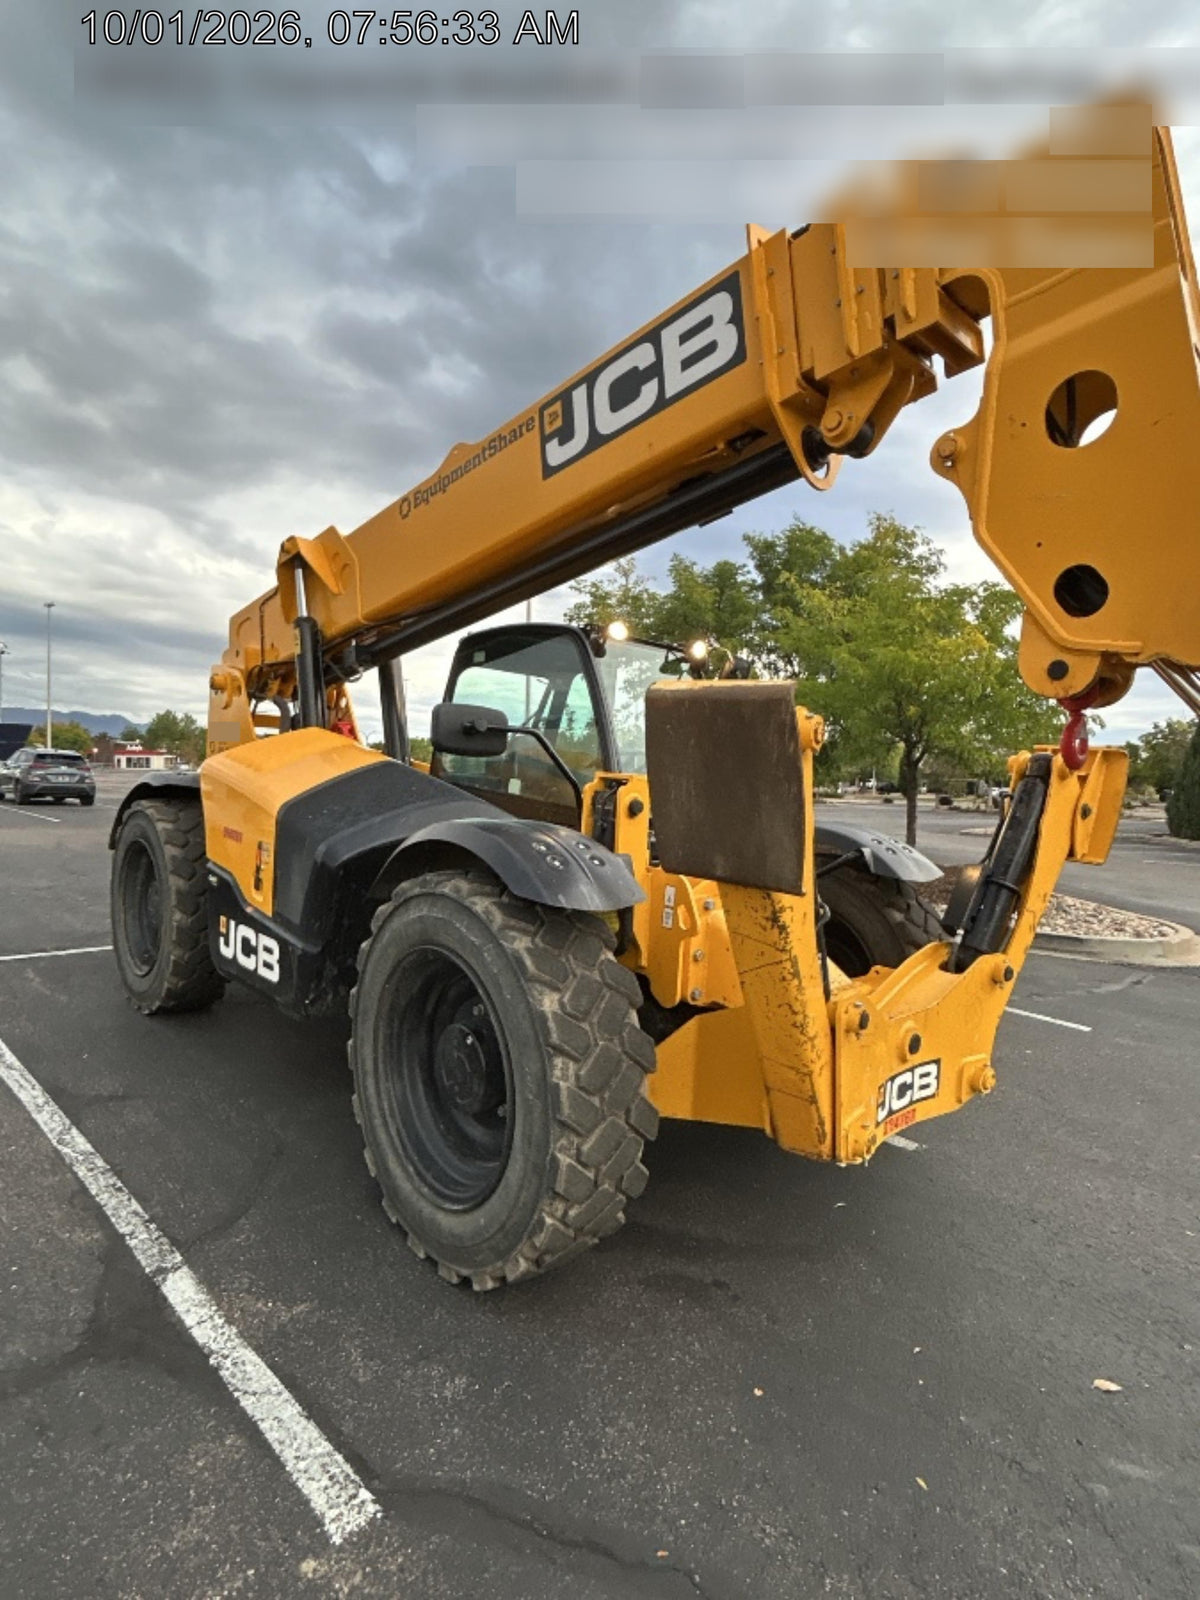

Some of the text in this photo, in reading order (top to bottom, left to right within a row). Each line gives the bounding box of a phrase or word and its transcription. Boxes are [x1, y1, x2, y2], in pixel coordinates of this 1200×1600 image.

[545, 290, 739, 467] JCB
[412, 415, 536, 510] EquipmentShare
[219, 920, 280, 983] JCB
[877, 1063, 938, 1123] JCB
